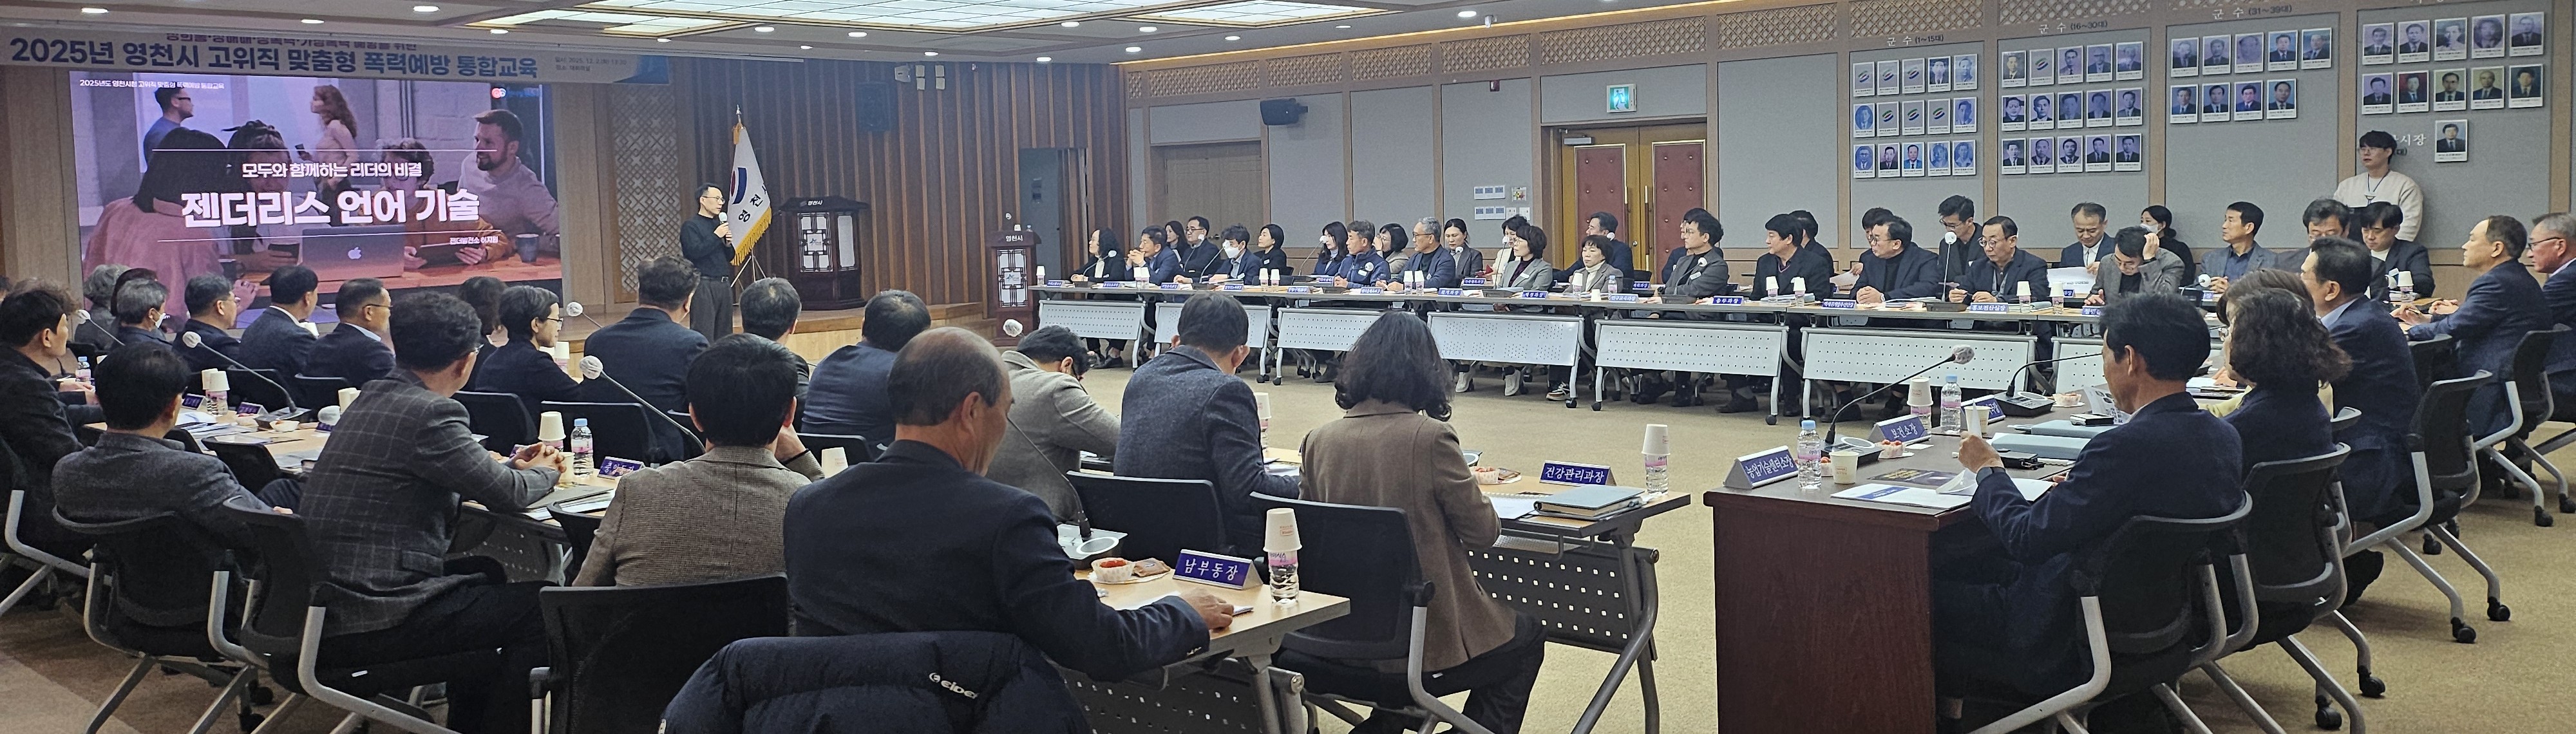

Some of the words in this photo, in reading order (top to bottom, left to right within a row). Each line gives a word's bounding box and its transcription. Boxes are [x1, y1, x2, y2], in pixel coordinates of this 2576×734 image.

[1887, 37, 1896, 46] 군
[1902, 35, 1911, 46] 수
[10, 37, 115, 64] 2025년
[123, 42, 199, 68] 영천시
[208, 46, 279, 70] 고위직
[288, 49, 355, 73] 맞춤형
[364, 52, 450, 75] 폭력예방
[457, 55, 537, 79] 통합교육
[2392, 133, 2427, 147] 시장
[242, 162, 288, 178] 모두와
[290, 162, 348, 178] 함께하는
[350, 162, 392, 177] 리더의
[393, 162, 422, 177] 비결
[181, 190, 331, 229] 젠더리스
[338, 189, 406, 224] 언어
[415, 189, 480, 221] 기술
[1890, 422, 1918, 440] 보건소장
[1545, 466, 1605, 484] 건강관리과장
[1745, 454, 1794, 480] 농업기술센터소장
[1184, 558, 1238, 581] 남부동장
